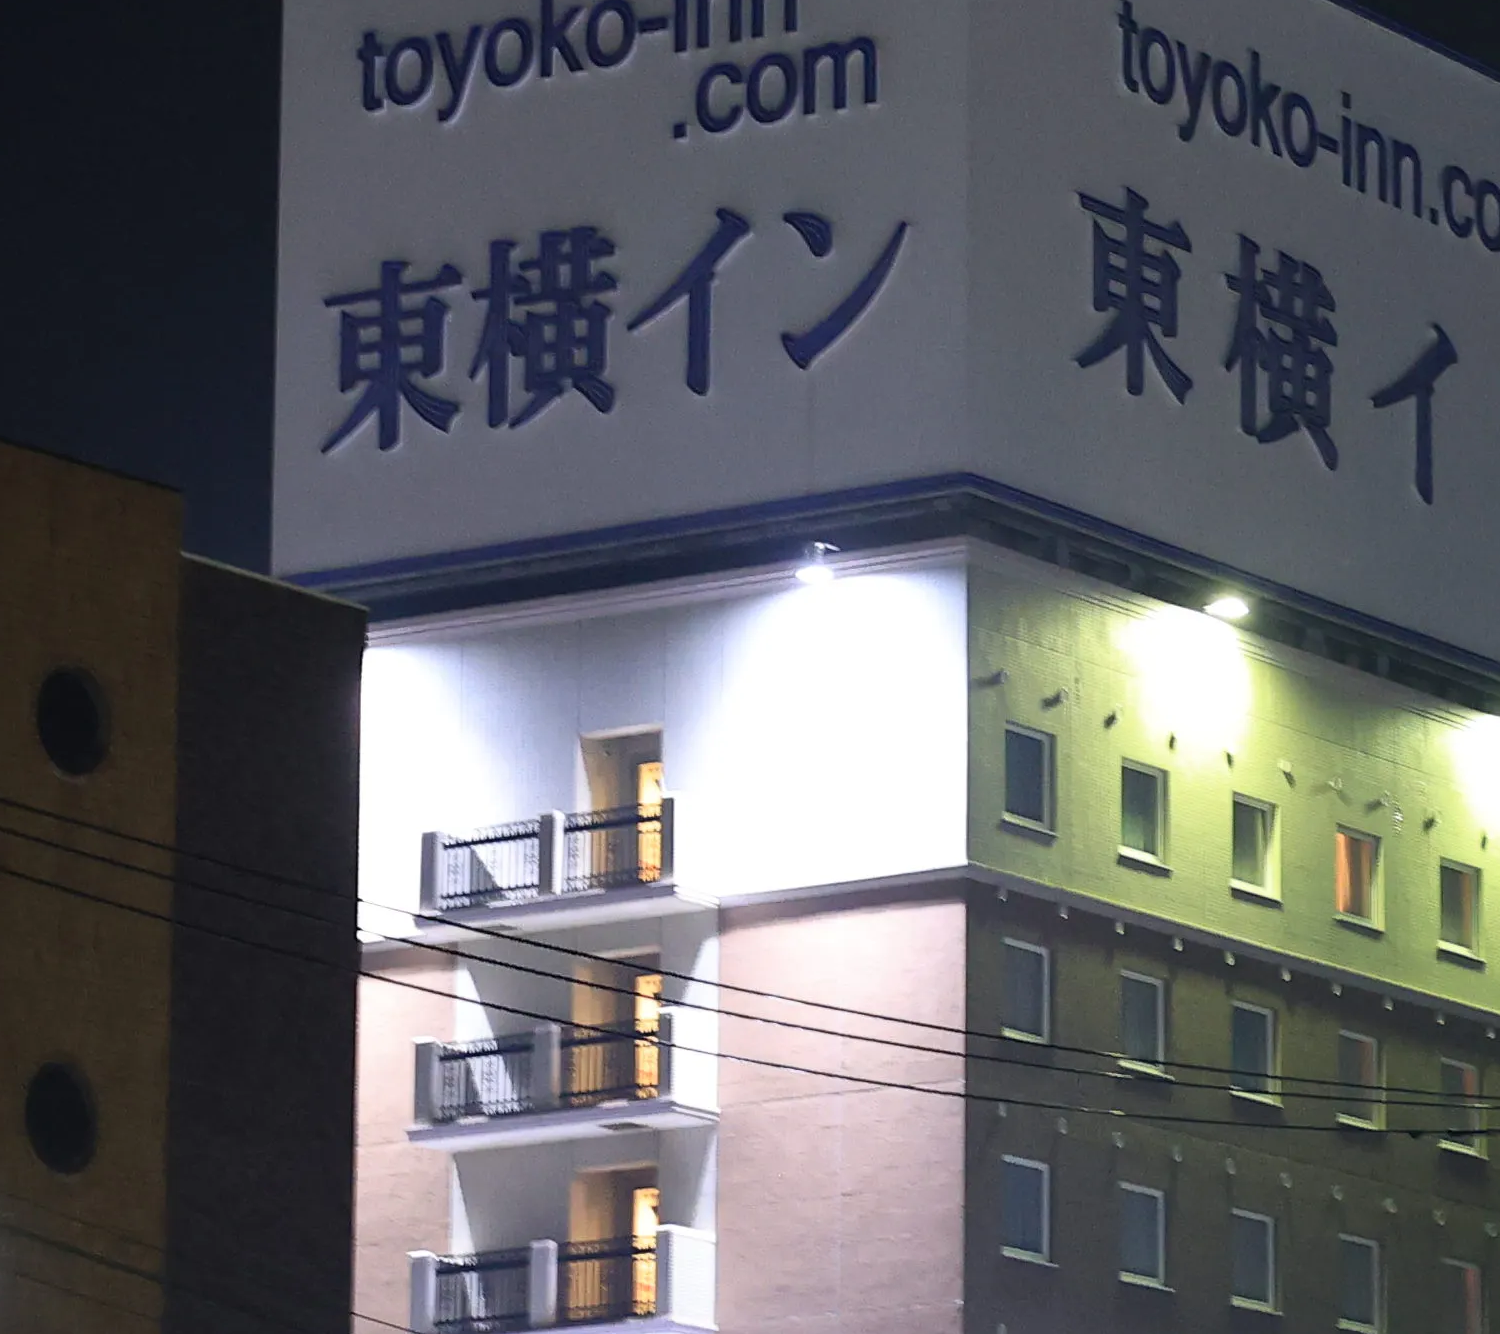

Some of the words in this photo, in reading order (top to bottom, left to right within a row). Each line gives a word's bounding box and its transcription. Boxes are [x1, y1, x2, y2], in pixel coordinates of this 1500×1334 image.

[672, 26, 878, 140] .com
[320, 207, 910, 455] 東横イン
